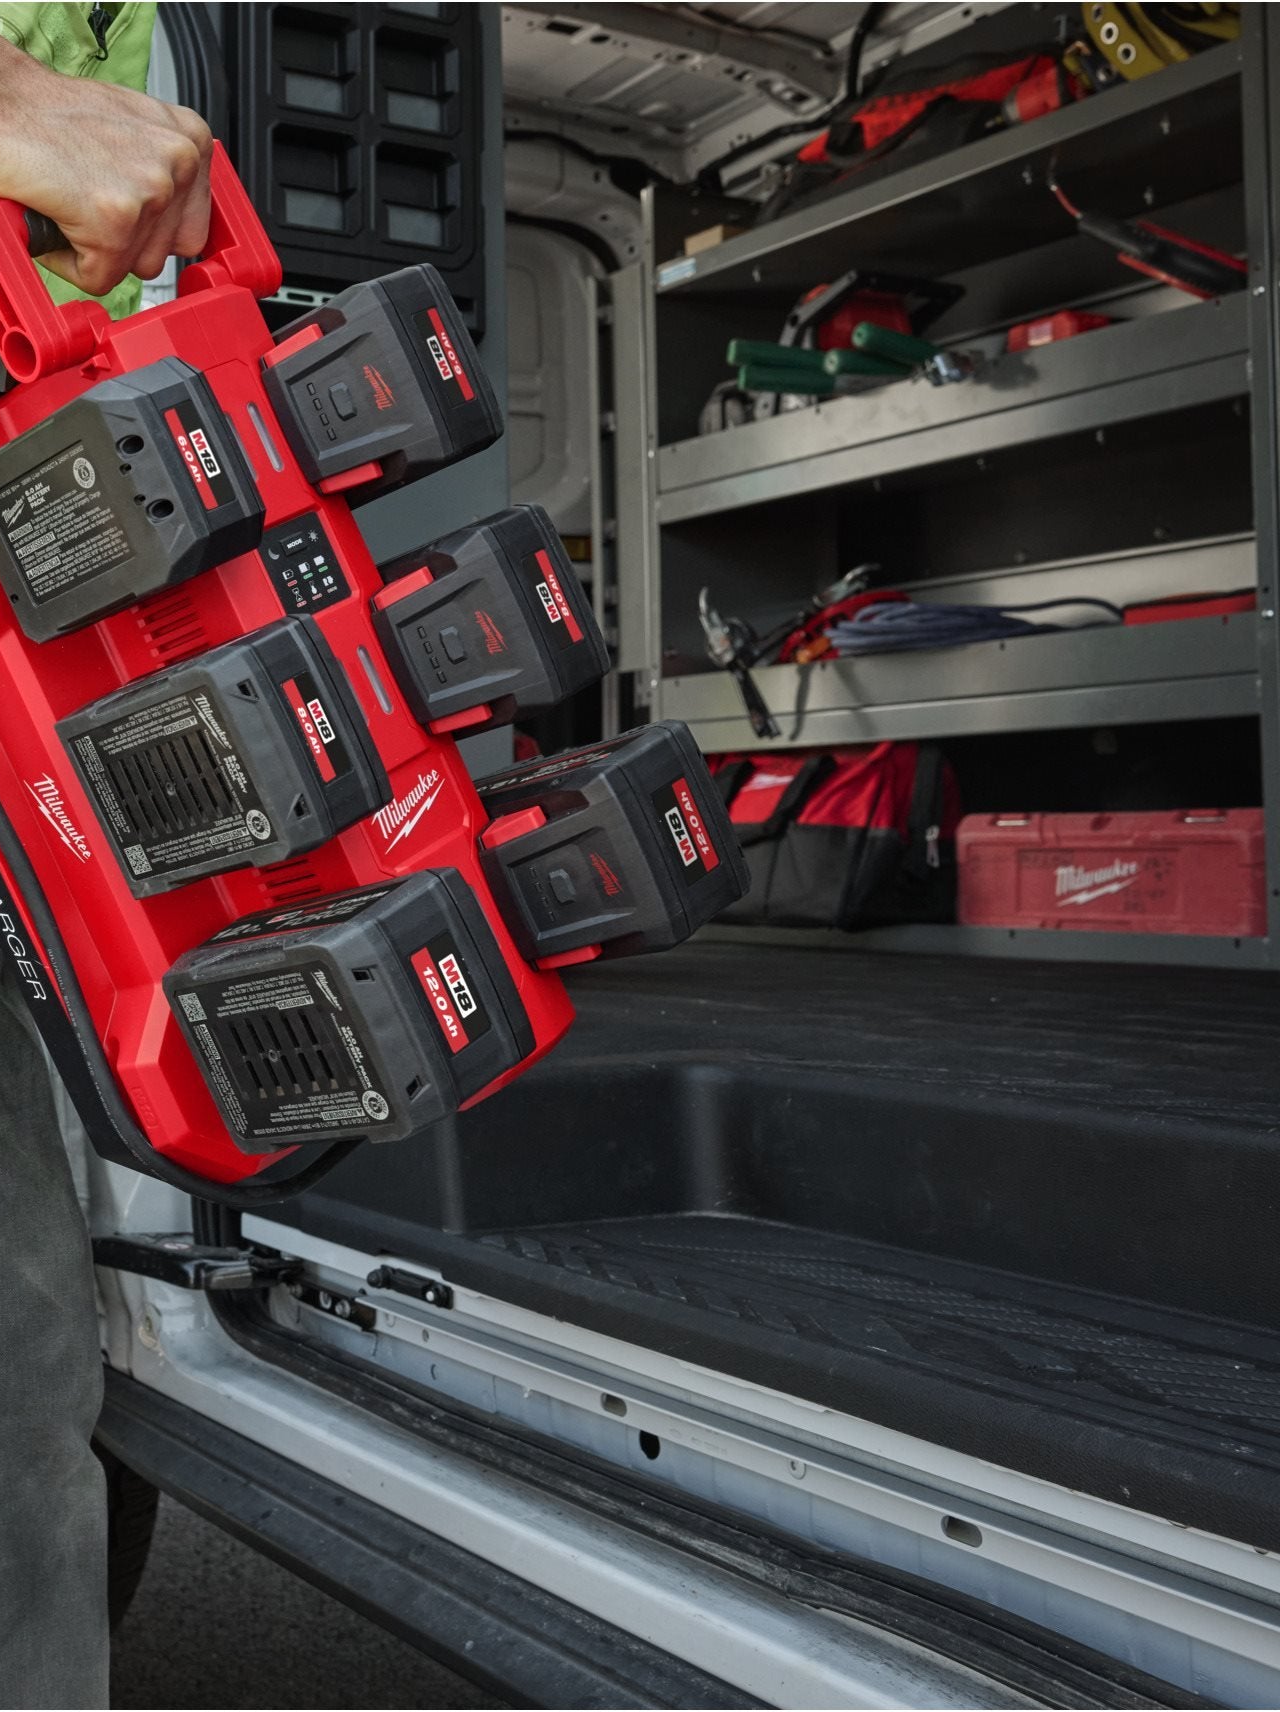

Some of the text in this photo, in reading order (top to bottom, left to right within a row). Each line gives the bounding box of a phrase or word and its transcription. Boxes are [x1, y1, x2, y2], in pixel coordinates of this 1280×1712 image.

[428, 339, 452, 378] M18
[441, 331, 462, 375] 6.0 Ah
[178, 435, 202, 483] 6.0 Ah
[191, 431, 218, 475] M18
[27, 485, 50, 501] BATTERY
[30, 496, 45, 507] PACK
[538, 585, 560, 621] M18
[195, 693, 232, 748] Milwaukee
[297, 707, 322, 754] 8.0 Ah
[309, 701, 333, 740] M18
[224, 756, 236, 780] PACK
[228, 757, 247, 794] BATTERY
[33, 772, 92, 861] Milwaukee
[372, 769, 441, 839] Milwaukee
[680, 791, 711, 855] 12.0 Ah
[668, 811, 695, 863] M18
[1055, 858, 1138, 897] Milwaukee
[314, 969, 340, 1008] Milwaukee
[423, 966, 459, 1038] 12.0 Ah
[442, 958, 474, 1012] M18
[341, 1027, 372, 1088] BATTERY PACK
